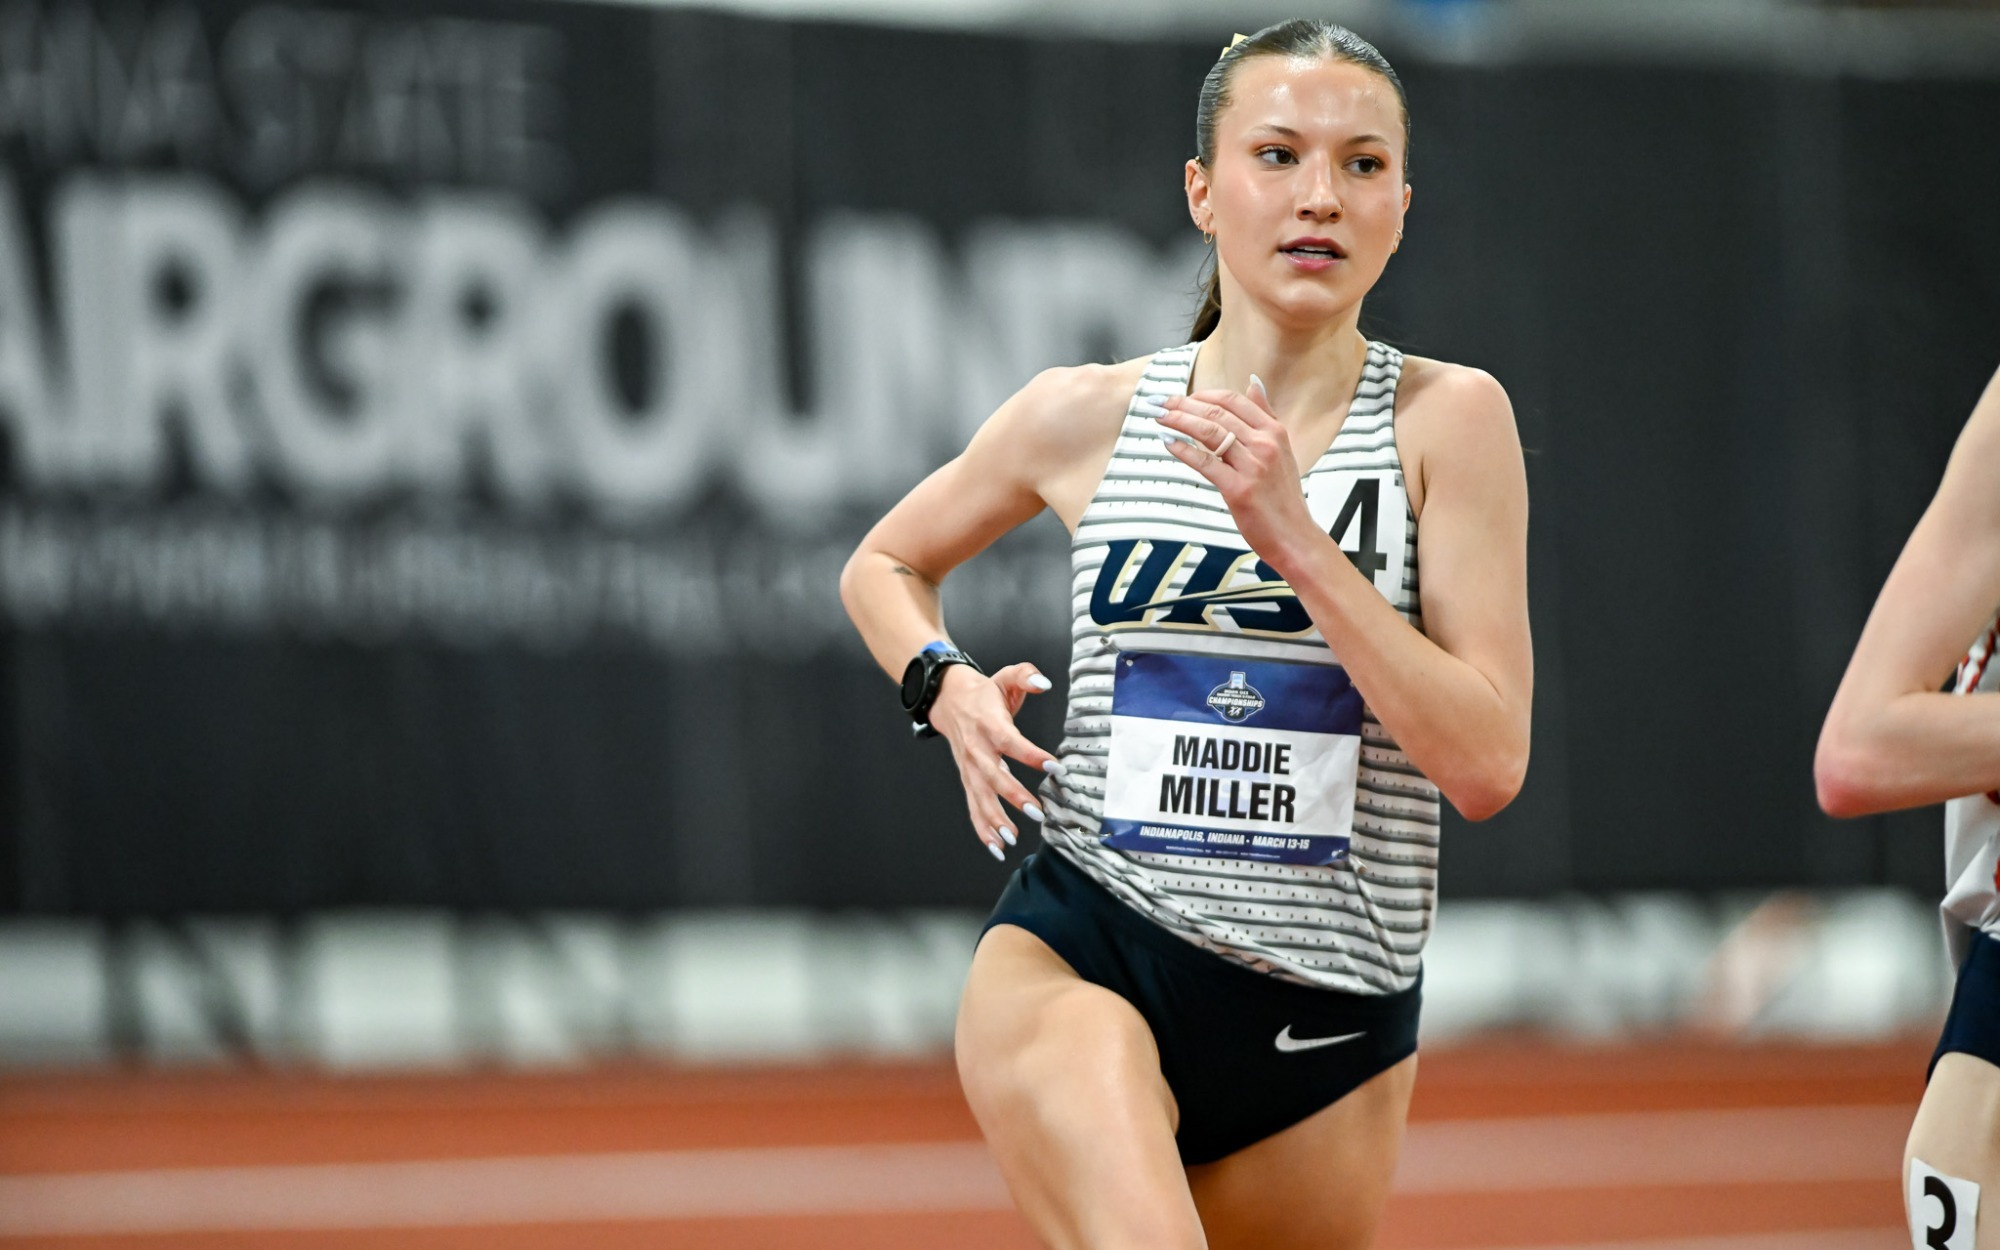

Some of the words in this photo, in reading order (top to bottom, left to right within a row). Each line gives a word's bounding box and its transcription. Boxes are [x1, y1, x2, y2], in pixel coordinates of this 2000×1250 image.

[1328, 478, 1388, 584] 4
[1208, 696, 1264, 708] CHAMPIONSHIPS
[1172, 734, 1292, 775] MADDIE
[1159, 774, 1297, 823] MILLER
[1139, 825, 1206, 843] INDIANAPOLIS,
[1206, 832, 1245, 845] INDIANA
[1252, 836, 1286, 848] MARCH
[1287, 838, 1310, 850] 13-15
